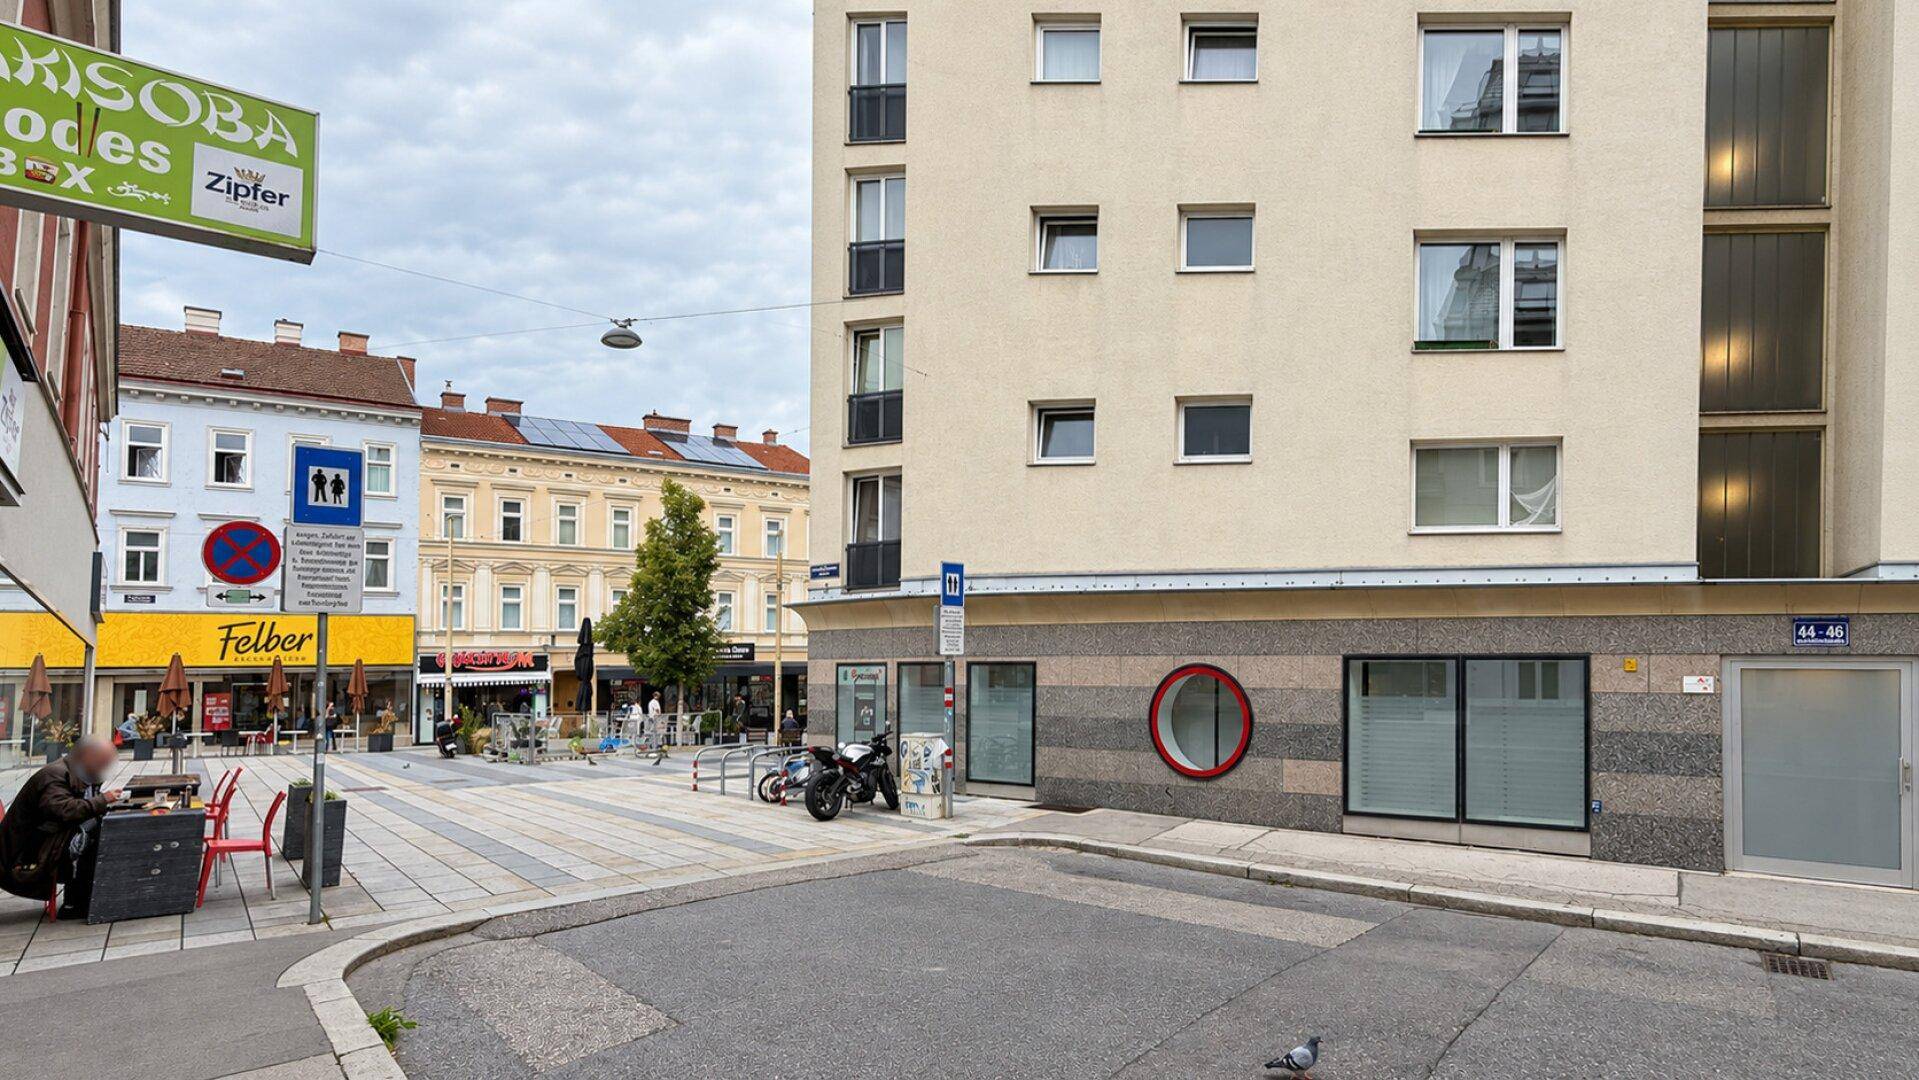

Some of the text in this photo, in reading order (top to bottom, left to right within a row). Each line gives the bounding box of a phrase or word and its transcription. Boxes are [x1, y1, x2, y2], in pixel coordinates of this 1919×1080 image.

[205, 171, 290, 207] Zipfer
[218, 621, 313, 660] Felber
[1798, 625, 1816, 638] 44
[1826, 625, 1844, 638] 46
